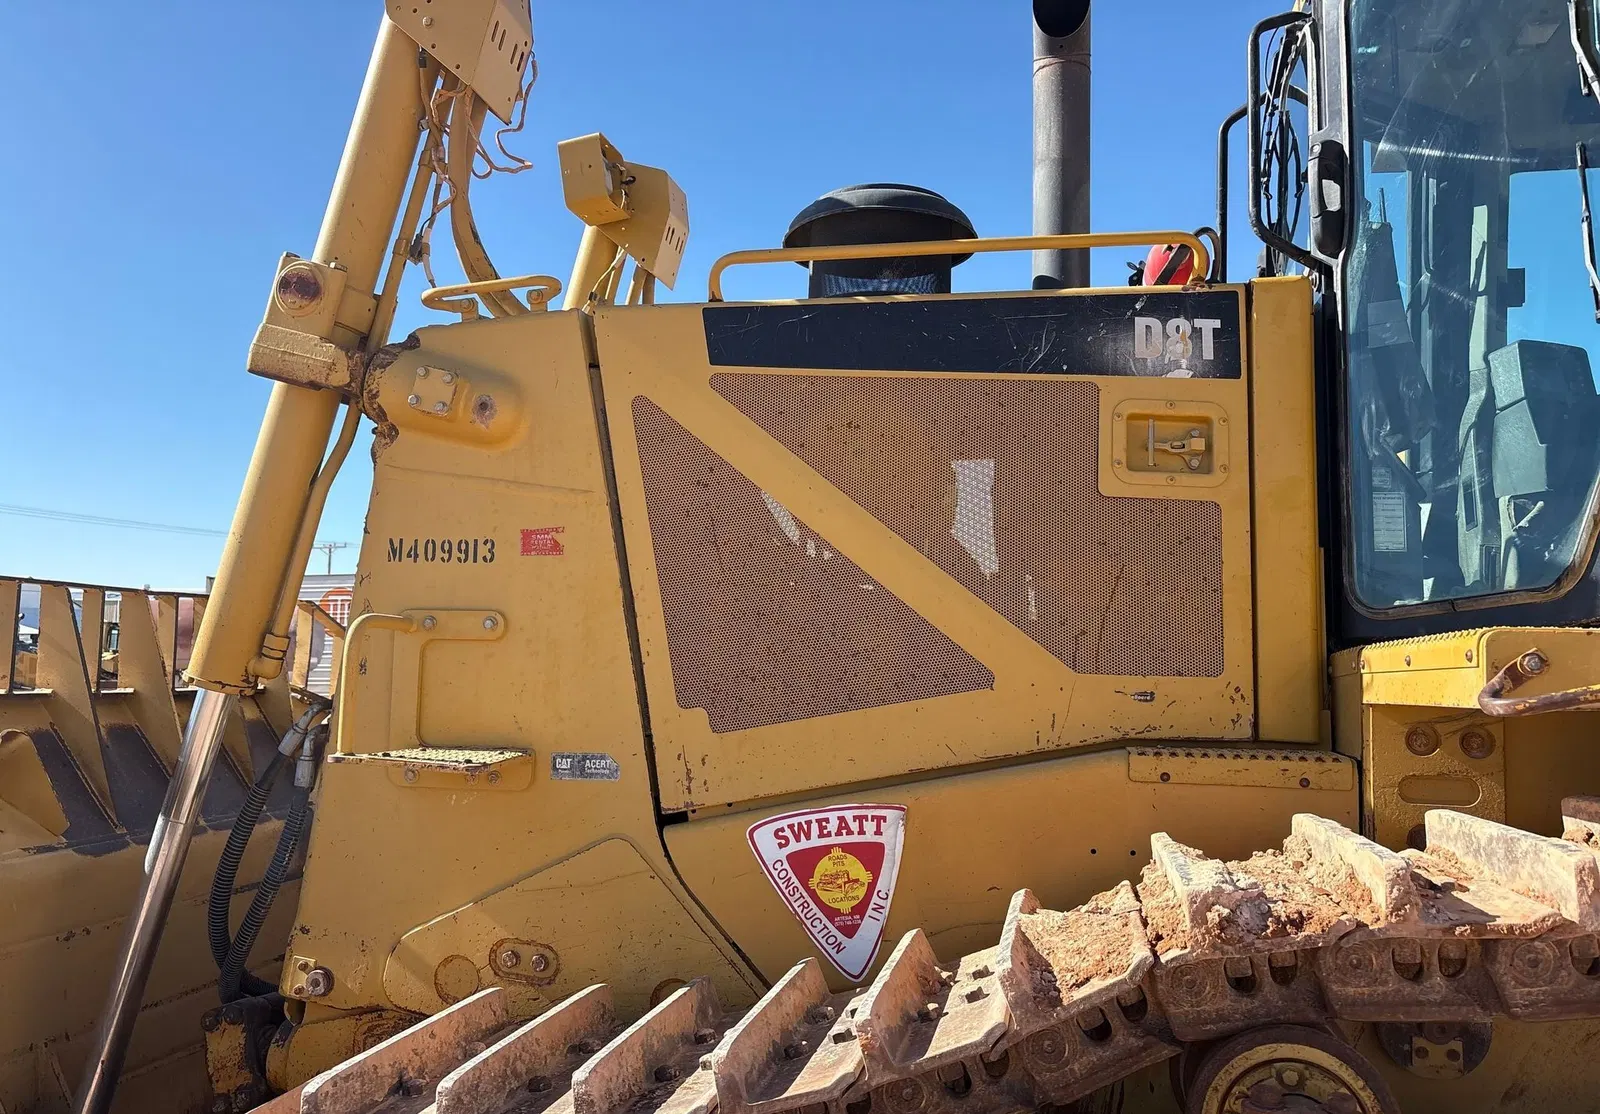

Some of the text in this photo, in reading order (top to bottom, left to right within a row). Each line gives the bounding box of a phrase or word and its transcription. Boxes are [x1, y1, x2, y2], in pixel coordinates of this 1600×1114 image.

[1135, 317, 1221, 360] D8T
[387, 537, 496, 564] M409913
[556, 758, 610, 768] CAT ACERT
[774, 815, 887, 850] SWEATT
[828, 853, 848, 861] ROADS
[772, 859, 847, 955] CONSTRUCTION
[828, 895, 860, 904] LOCATIONS
